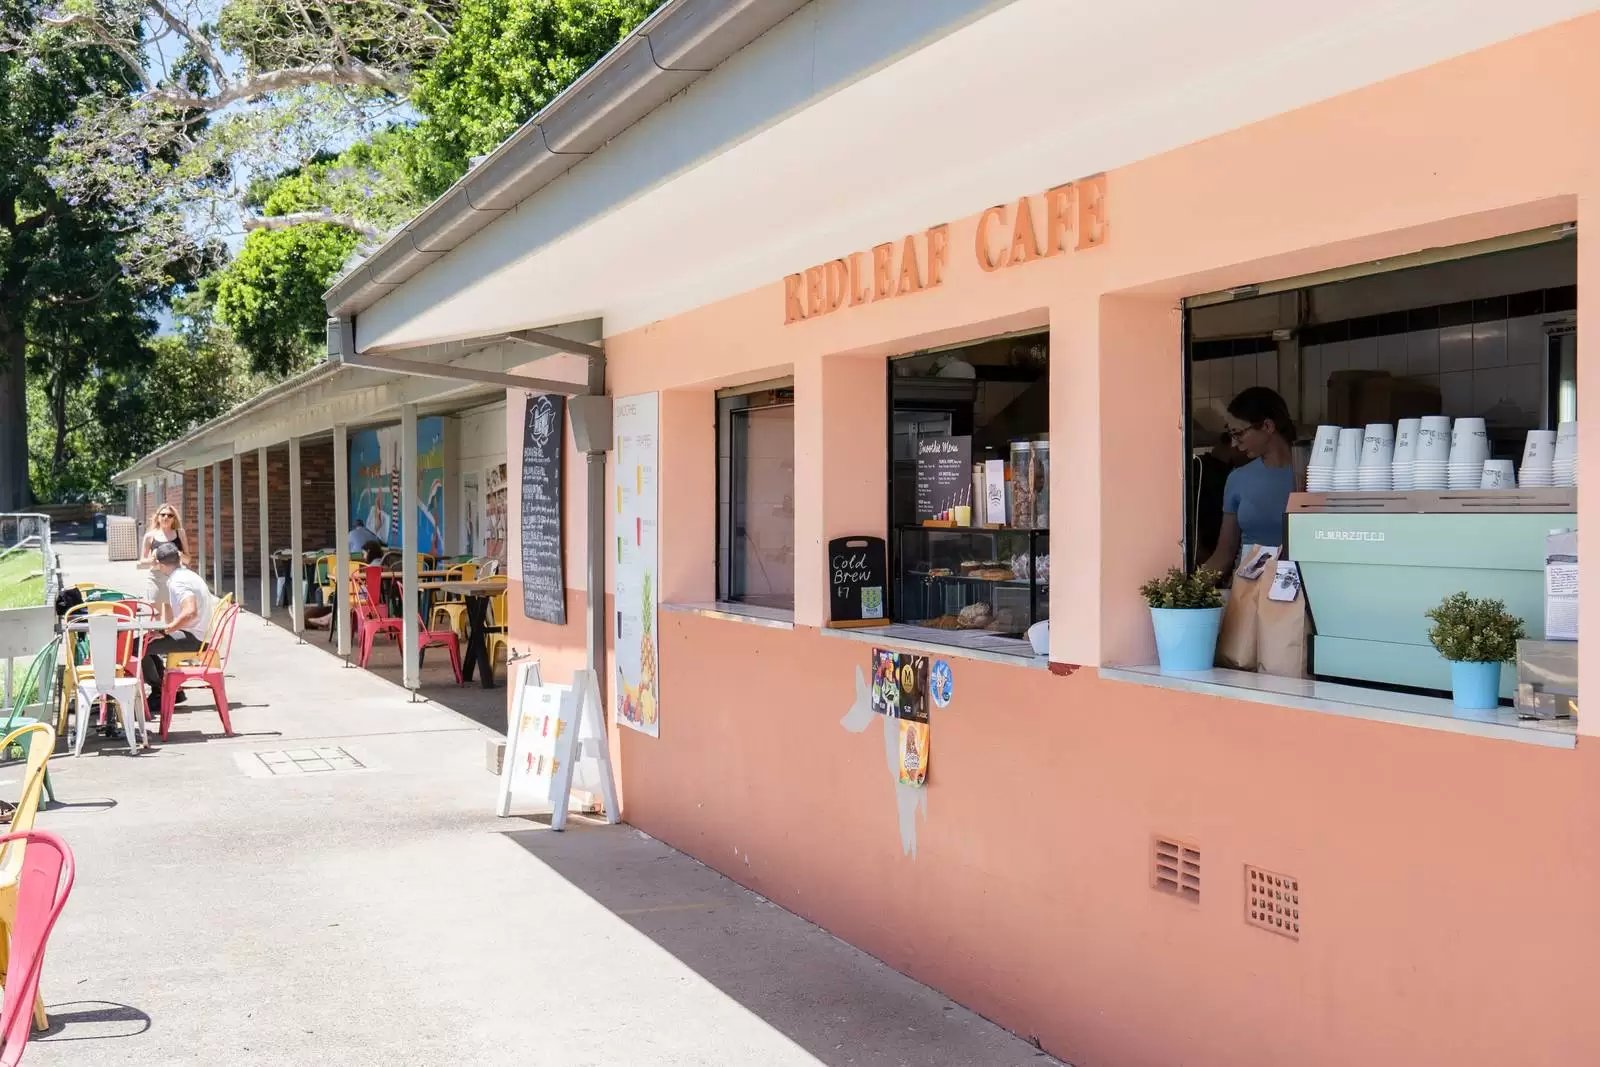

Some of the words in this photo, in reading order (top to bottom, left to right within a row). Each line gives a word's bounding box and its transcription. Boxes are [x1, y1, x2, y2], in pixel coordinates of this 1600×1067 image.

[784, 223, 949, 325] REDLEAF
[975, 171, 1107, 272] CAFE
[832, 553, 867, 569] Cold
[834, 570, 871, 584] Brew
